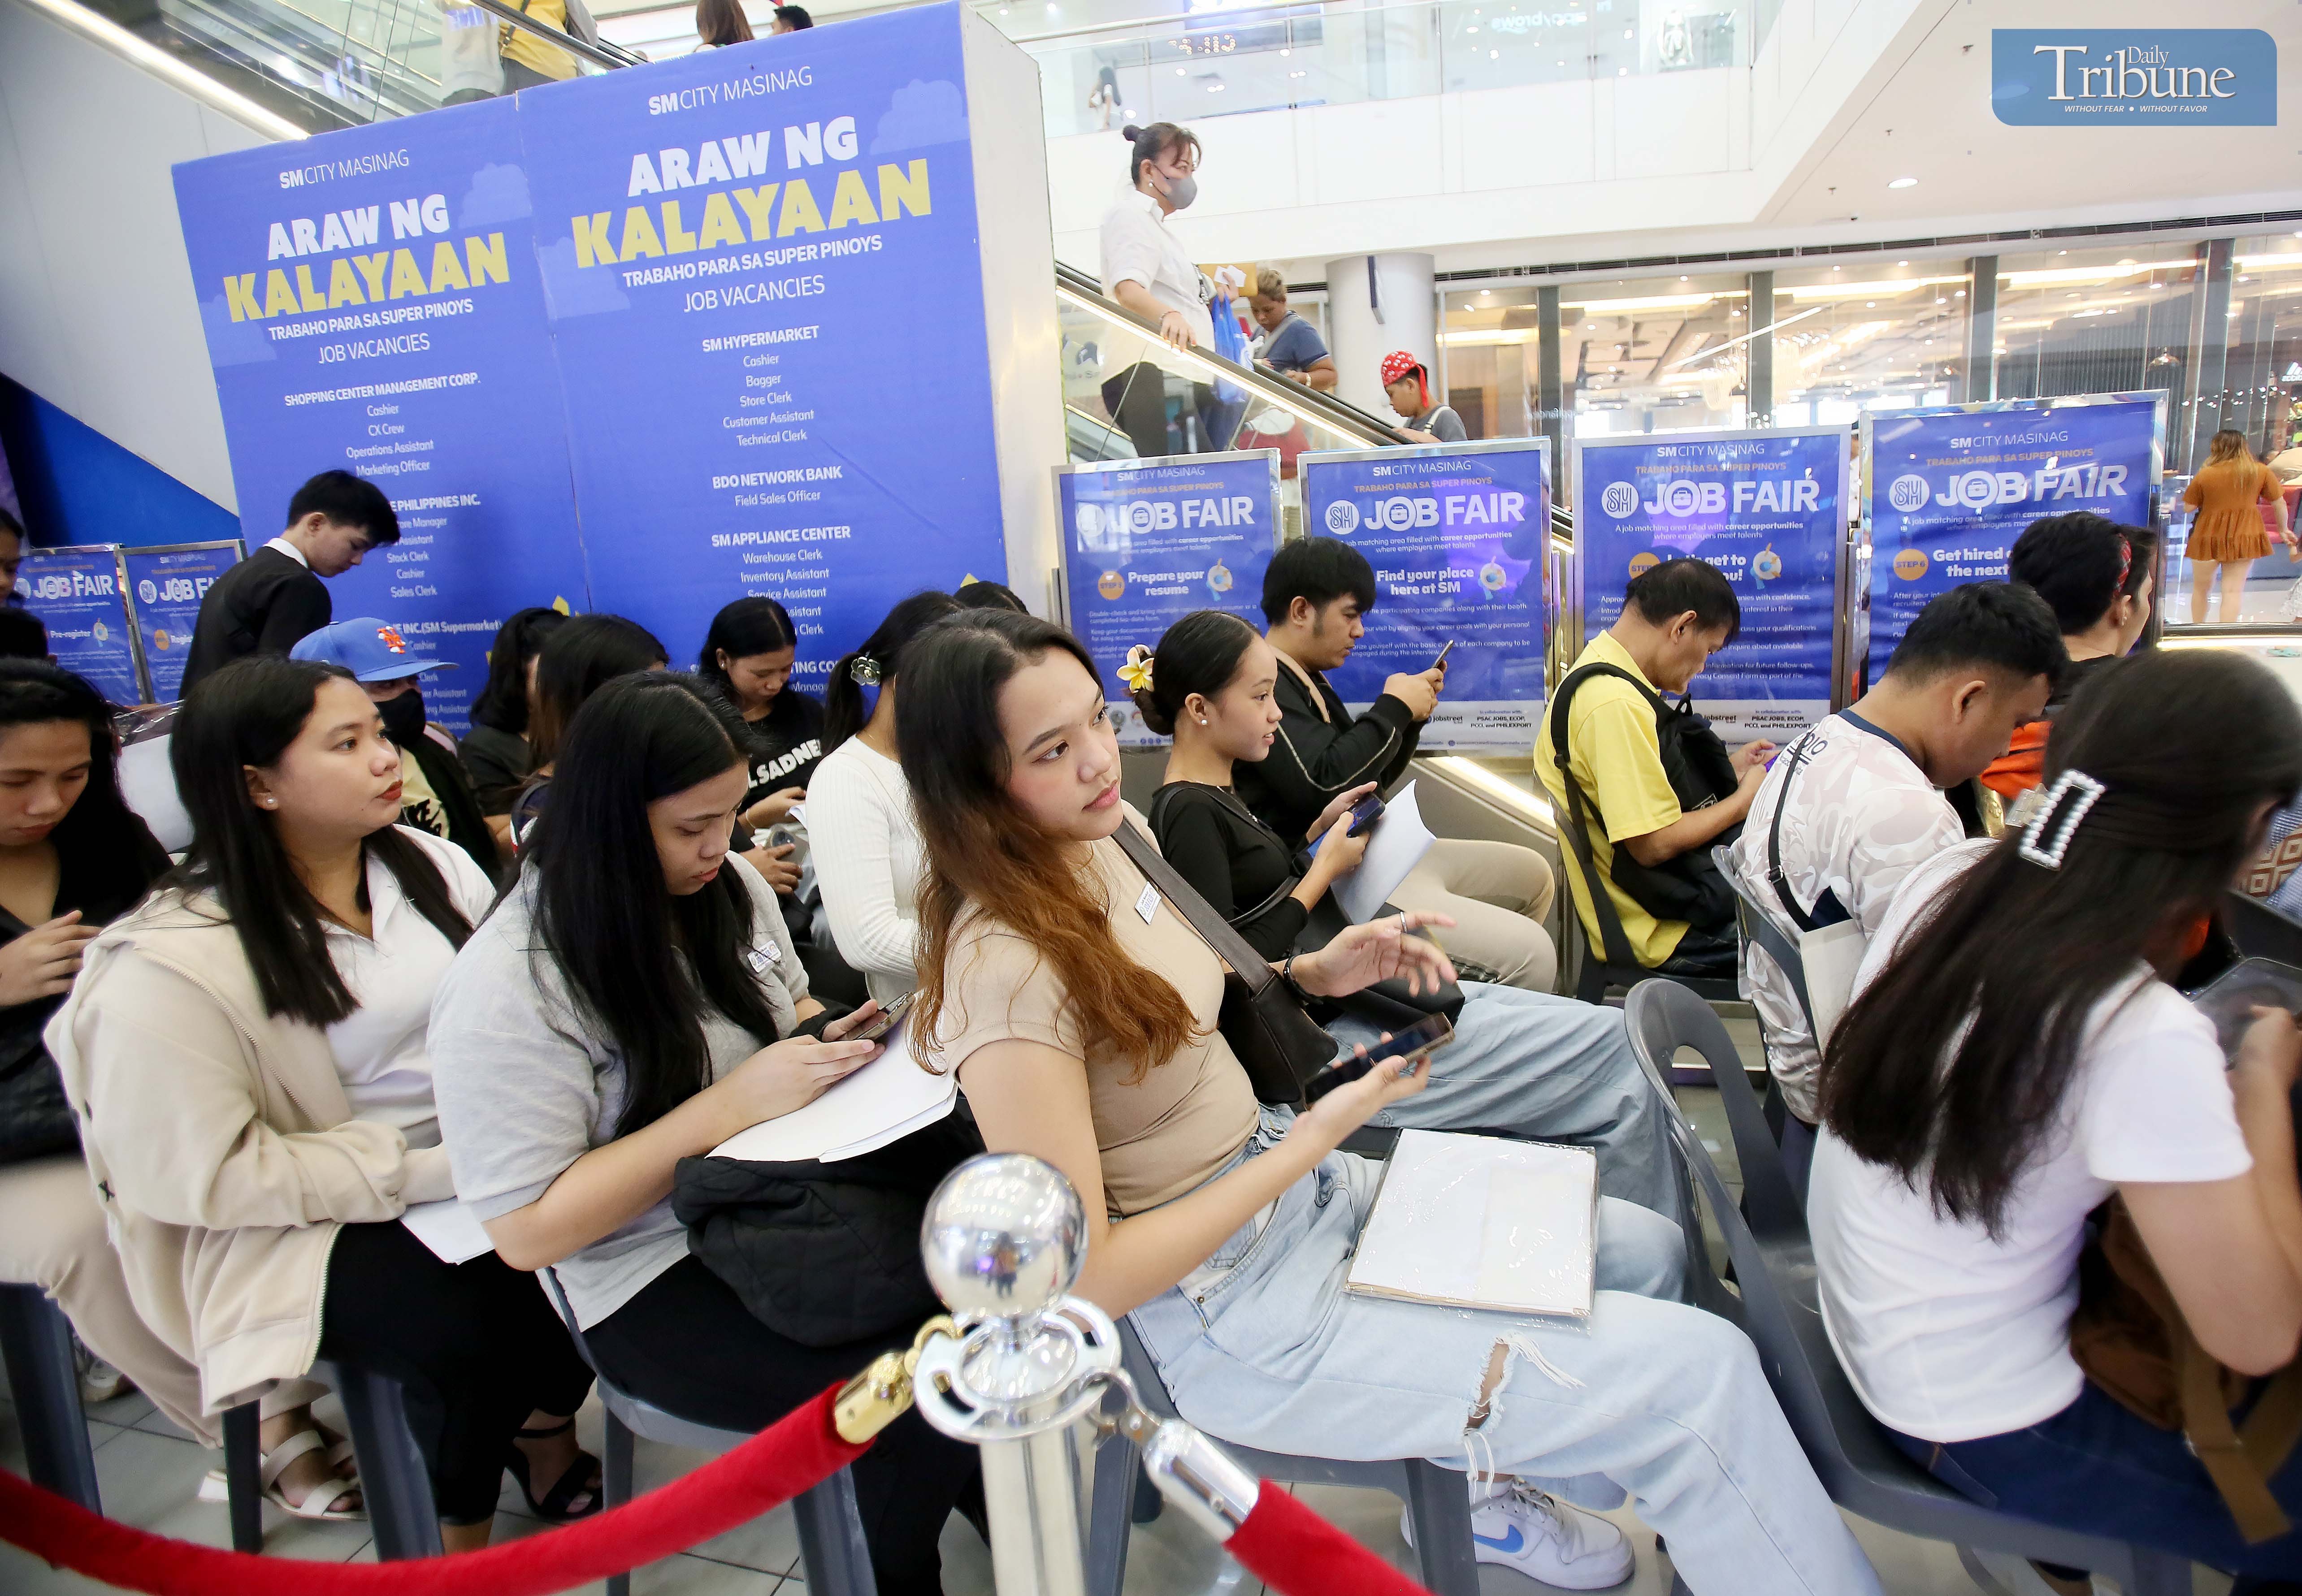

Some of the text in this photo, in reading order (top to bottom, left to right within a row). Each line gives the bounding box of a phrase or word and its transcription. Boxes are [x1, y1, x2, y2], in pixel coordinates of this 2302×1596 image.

[724, 66, 812, 101] MASINAG
[338, 149, 409, 178] MASINAG
[628, 116, 858, 197] ARAW NG
[571, 158, 932, 269] KALAYAAN
[268, 194, 450, 261] ARAW NG
[622, 234, 882, 287] TRABAHO PARA SA SUPER PINOYS
[223, 232, 510, 323] KALAYAAN
[684, 274, 825, 312] JOB VACANCIES
[268, 298, 473, 340] TRABAHO PARA SA SUPER PINOYS
[702, 325, 819, 352] SM HYPERMARKET
[319, 333, 430, 364] JOB VACANCIES
[743, 354, 780, 368] Cashier
[284, 372, 481, 406] SHOPPING CENTER MANAGEMENT CORP.
[746, 375, 781, 389] Bagger
[740, 390, 792, 407] Store Clerk
[367, 403, 399, 417] Cashier
[723, 409, 815, 428] Customer Assistant
[368, 423, 405, 436] CX Crew
[736, 428, 807, 446] Technical Clerk
[2005, 431, 2068, 445] MASINAG
[346, 439, 434, 460] Operations Assistant
[1708, 444, 1764, 456] MASINAG
[355, 460, 430, 476] Marketing Officer
[1419, 460, 1471, 473] MASINAG
[1636, 462, 1786, 474] TRABAHO PARA SA PINOYS
[1926, 455, 1974, 467] TRABAHO
[1976, 454, 2002, 464] PARA
[2004, 453, 2017, 463] SA
[712, 465, 843, 489] BDO NETWORK BANK
[1157, 467, 1205, 478] MASINAG
[1354, 477, 1492, 493] TRABAHO PARA SA SUPER PINOYS
[1936, 464, 2128, 508] JOB FAIR
[397, 495, 460, 511] PHILIPPINES
[460, 493, 481, 506] INC.
[735, 490, 821, 506] Field Sales Officer
[1643, 479, 1819, 517] JOB FAIR
[1182, 496, 1255, 528] FAIR
[1365, 492, 1525, 532] JOB FAIR
[1635, 523, 1669, 532] matching
[1725, 522, 1750, 530] career
[1751, 521, 1803, 532] opportunities
[711, 525, 851, 547] SM APPLIANCE CENTER
[1464, 531, 1512, 541] opportunities
[742, 548, 823, 564] Warehouse Clerk
[1397, 544, 1433, 553] employers
[1933, 546, 2003, 562] Get hired
[1731, 554, 1746, 567] to
[741, 567, 829, 583] Inventory Assistant
[1128, 571, 1205, 584] Prepare your
[1376, 567, 1474, 583] Find your place
[1946, 563, 2010, 577] the next
[73, 575, 114, 597] FAIR
[160, 578, 195, 602] JOB
[783, 587, 826, 599] Assistant
[1145, 586, 1189, 596] resume
[1390, 581, 1461, 596] here at SM
[788, 606, 821, 617] ssistant
[1421, 606, 1456, 614] companies
[799, 623, 823, 635] Clerk
[1503, 621, 1530, 629] personal
